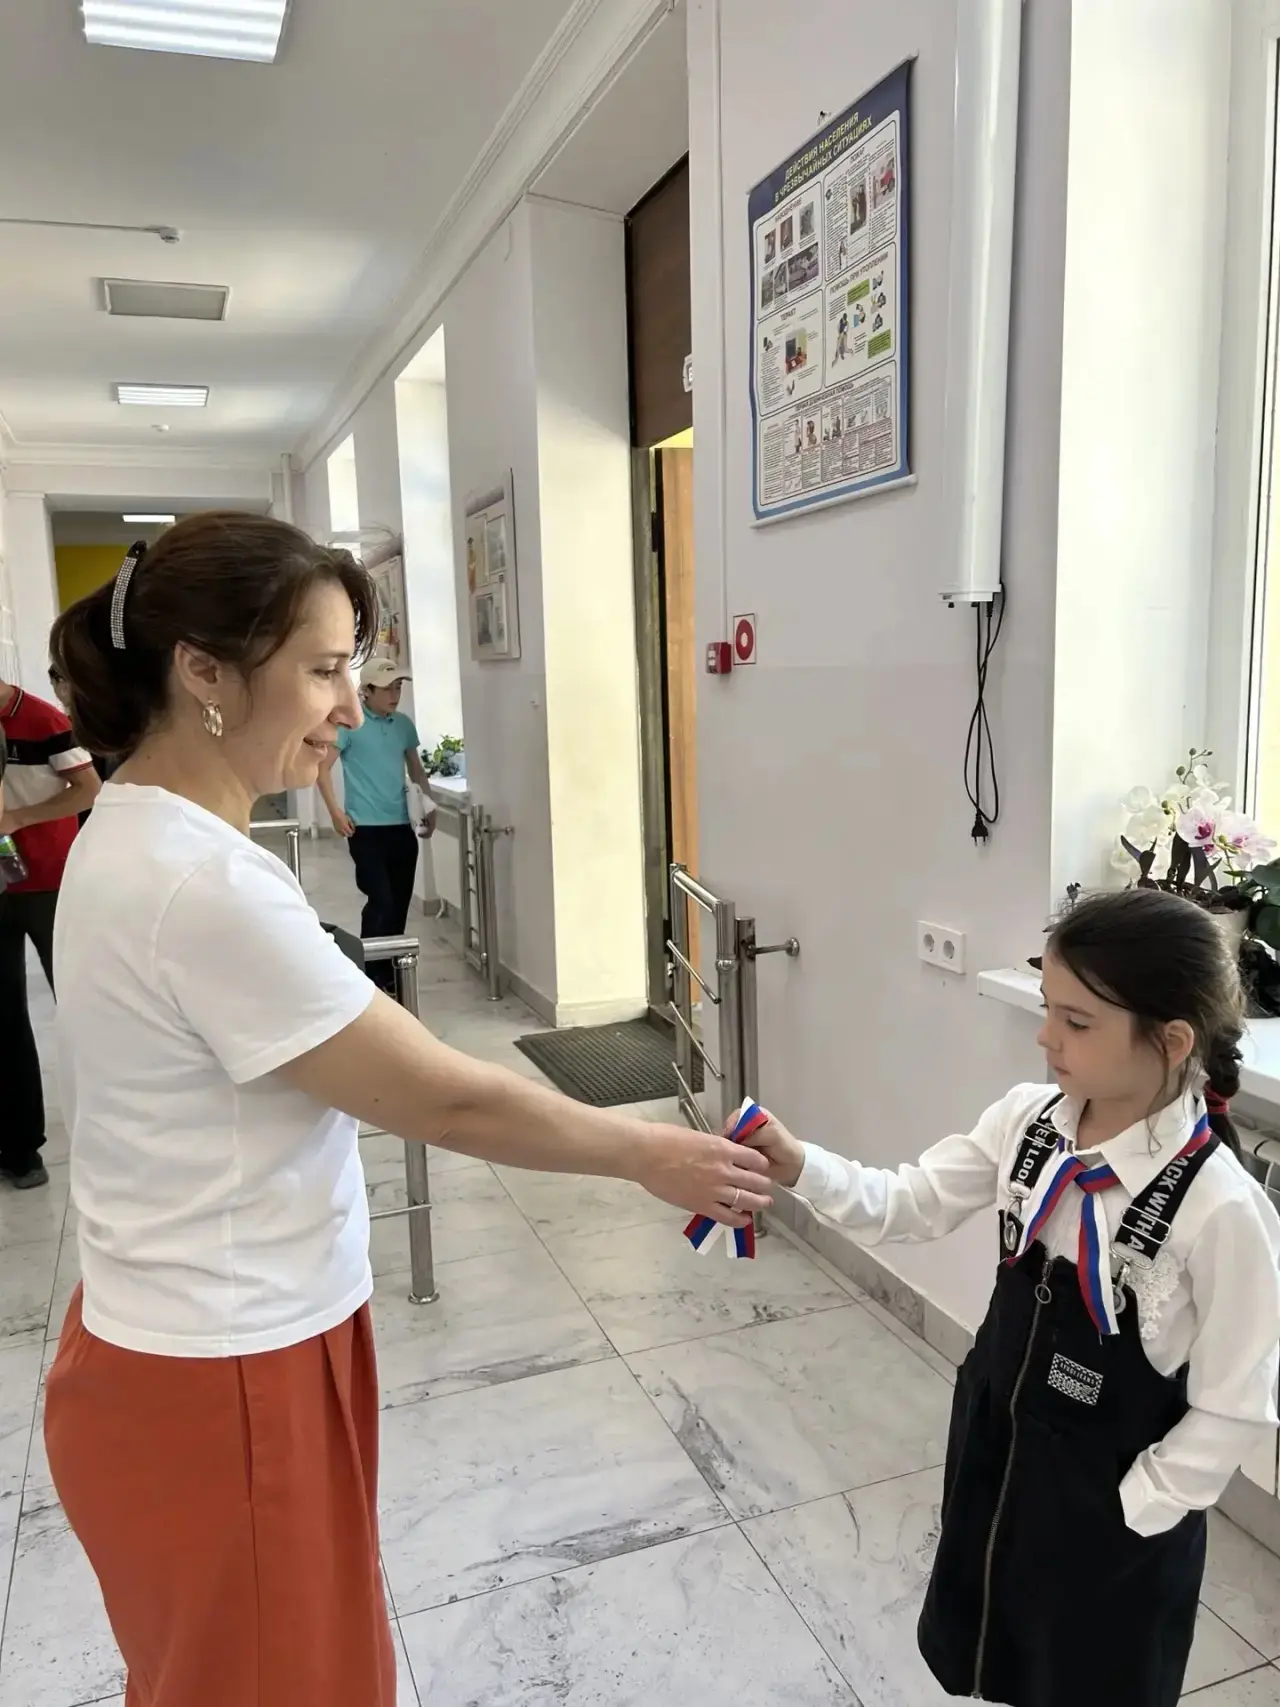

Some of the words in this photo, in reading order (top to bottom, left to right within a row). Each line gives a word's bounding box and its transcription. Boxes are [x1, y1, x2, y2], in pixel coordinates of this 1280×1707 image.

[781, 149, 832, 197] ЧРЕЗВЫЧАЙНЫХ
[833, 114, 872, 156] СИТУАЦИЯХ
[784, 145, 818, 182] ДЕЙСТВИЯ
[819, 112, 859, 153] НАСЕЛЕНИЯ
[1158, 1150, 1198, 1192] ACK
[1134, 1191, 1170, 1236] WITH
